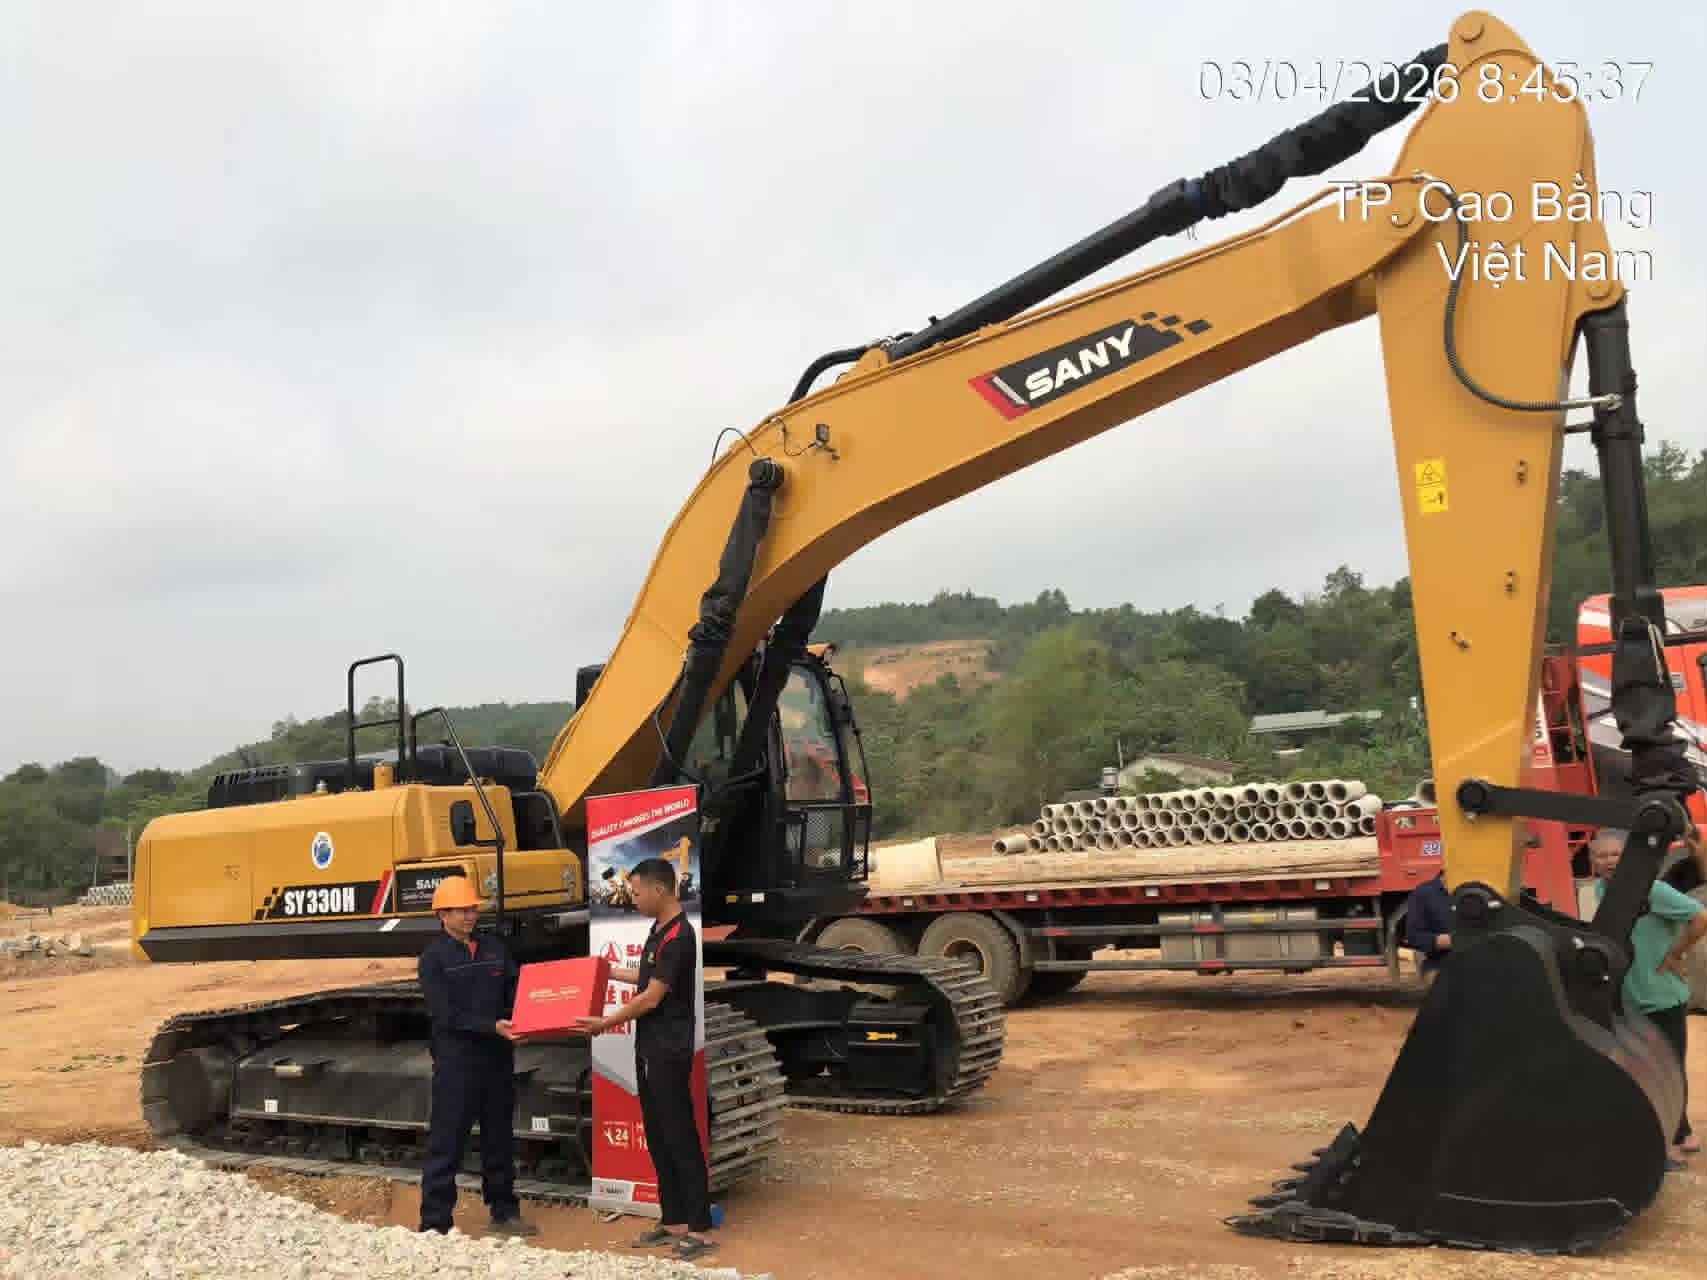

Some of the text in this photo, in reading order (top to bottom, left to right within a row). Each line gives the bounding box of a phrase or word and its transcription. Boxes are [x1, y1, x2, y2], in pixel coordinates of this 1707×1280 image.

[1025, 326, 1135, 400] SANY
[664, 799, 690, 814] WORLD
[416, 879, 442, 890] SAN
[284, 887, 355, 915] SY330H
[615, 1128, 629, 1140] 24
